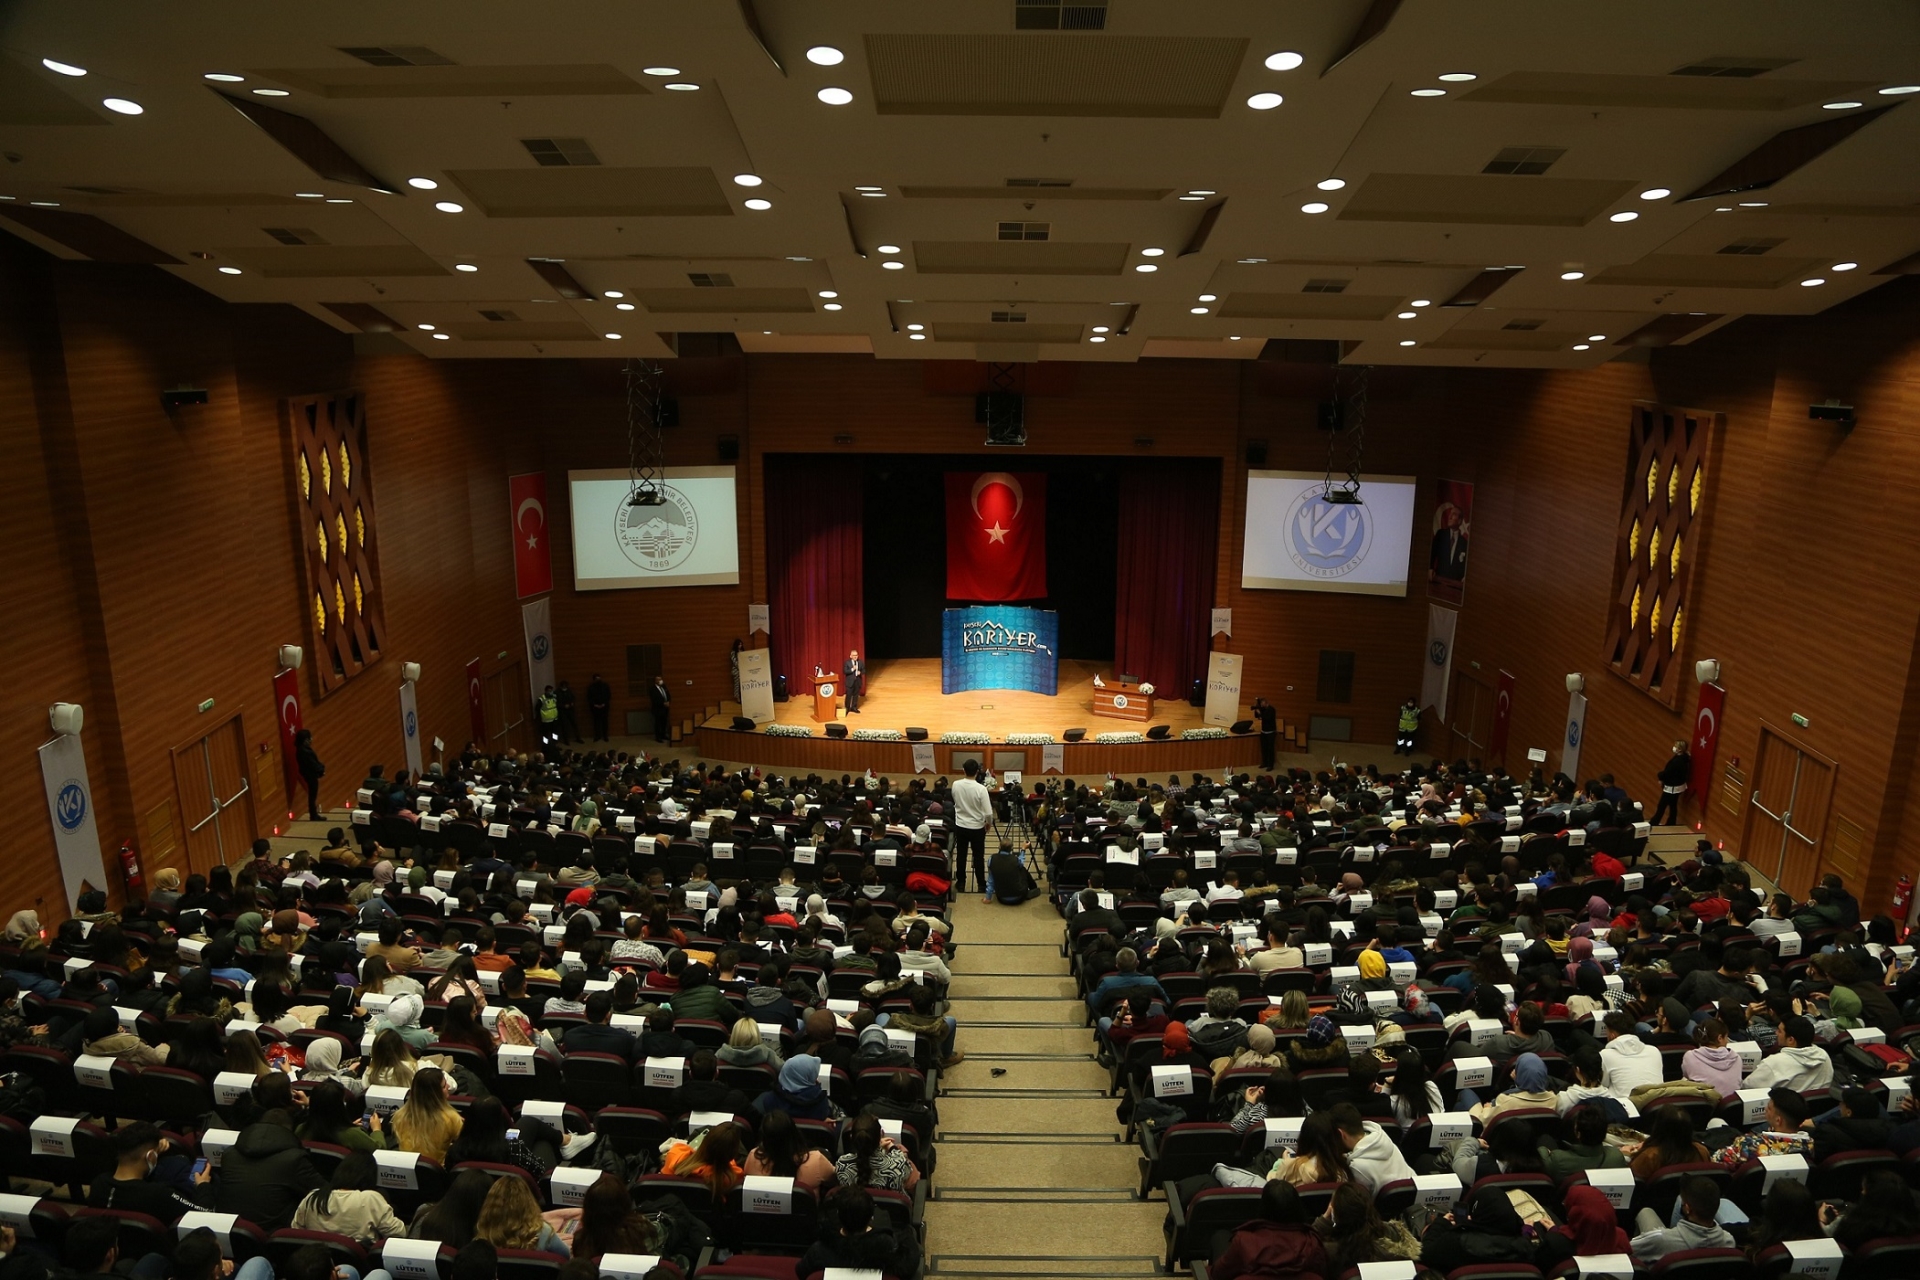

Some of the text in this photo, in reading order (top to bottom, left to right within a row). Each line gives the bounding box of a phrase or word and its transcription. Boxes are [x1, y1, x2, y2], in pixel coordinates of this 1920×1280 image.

[619, 508, 630, 547] KAYSERİ
[649, 560, 670, 568] 1869
[395, 1266, 425, 1275] LÜTFEN
